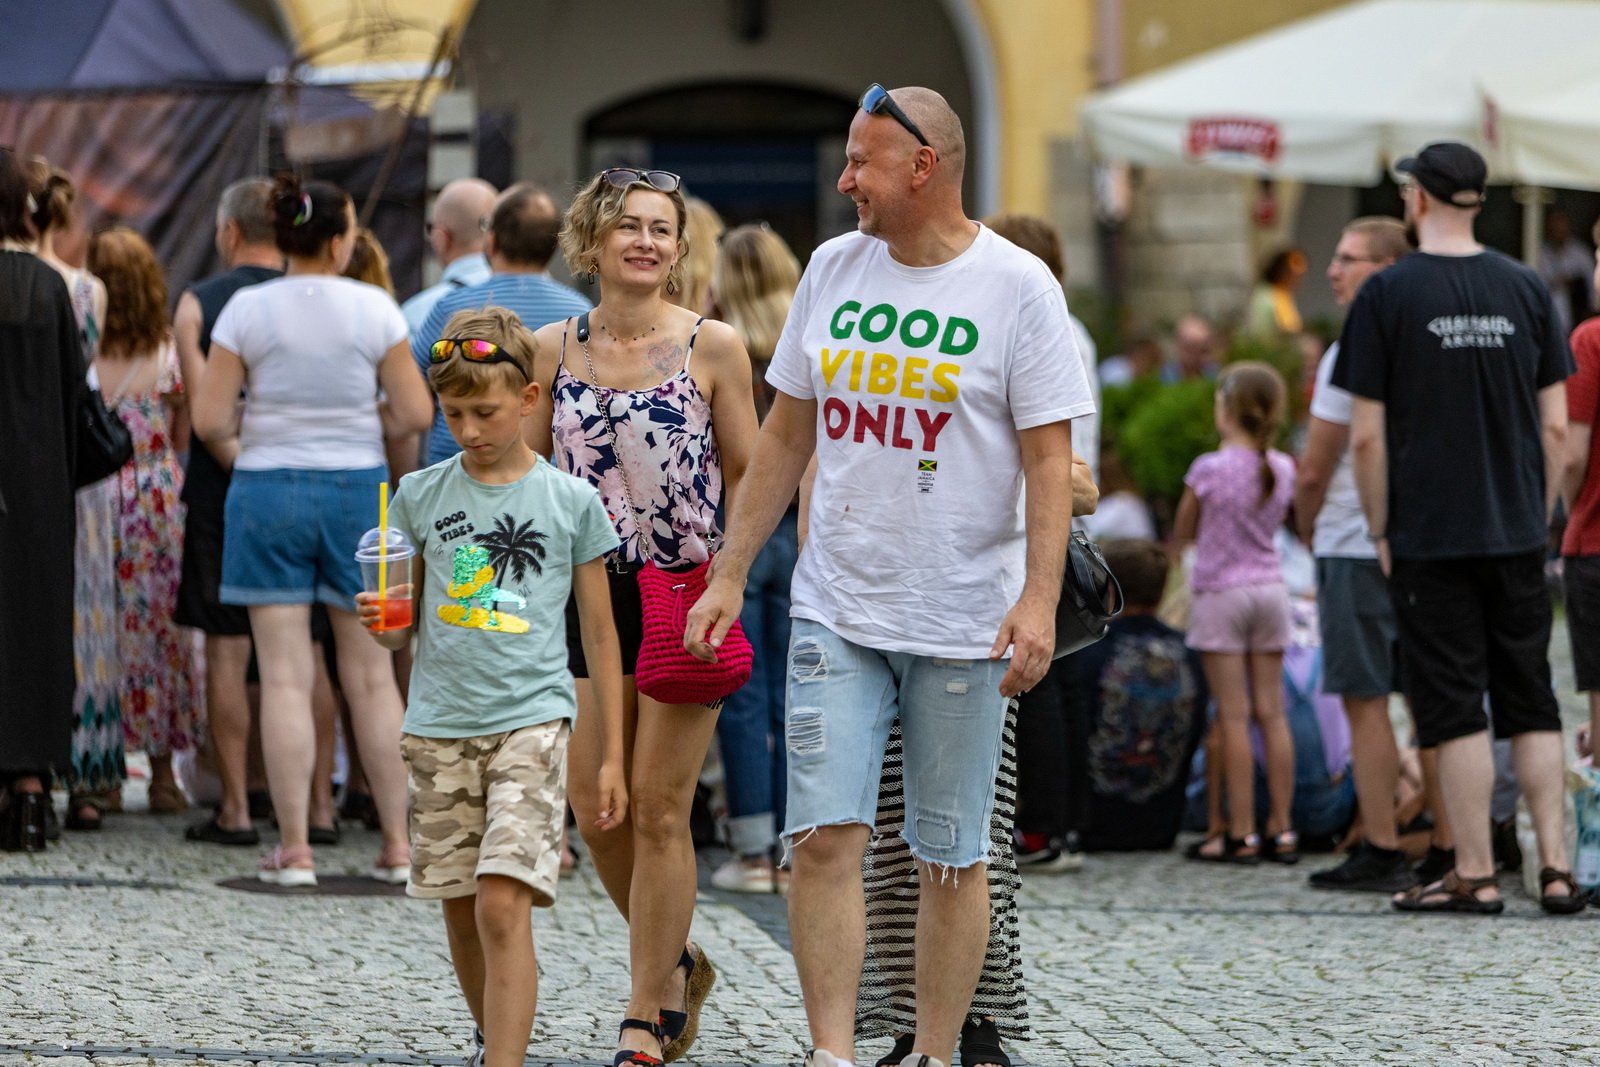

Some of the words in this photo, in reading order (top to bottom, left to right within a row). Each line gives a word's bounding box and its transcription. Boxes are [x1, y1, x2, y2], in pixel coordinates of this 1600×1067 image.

[830, 300, 979, 356] GOOD
[820, 347, 961, 404] VIBES
[823, 396, 953, 453] ONLY
[434, 510, 467, 531] GOOD
[440, 522, 475, 542] VIBES
